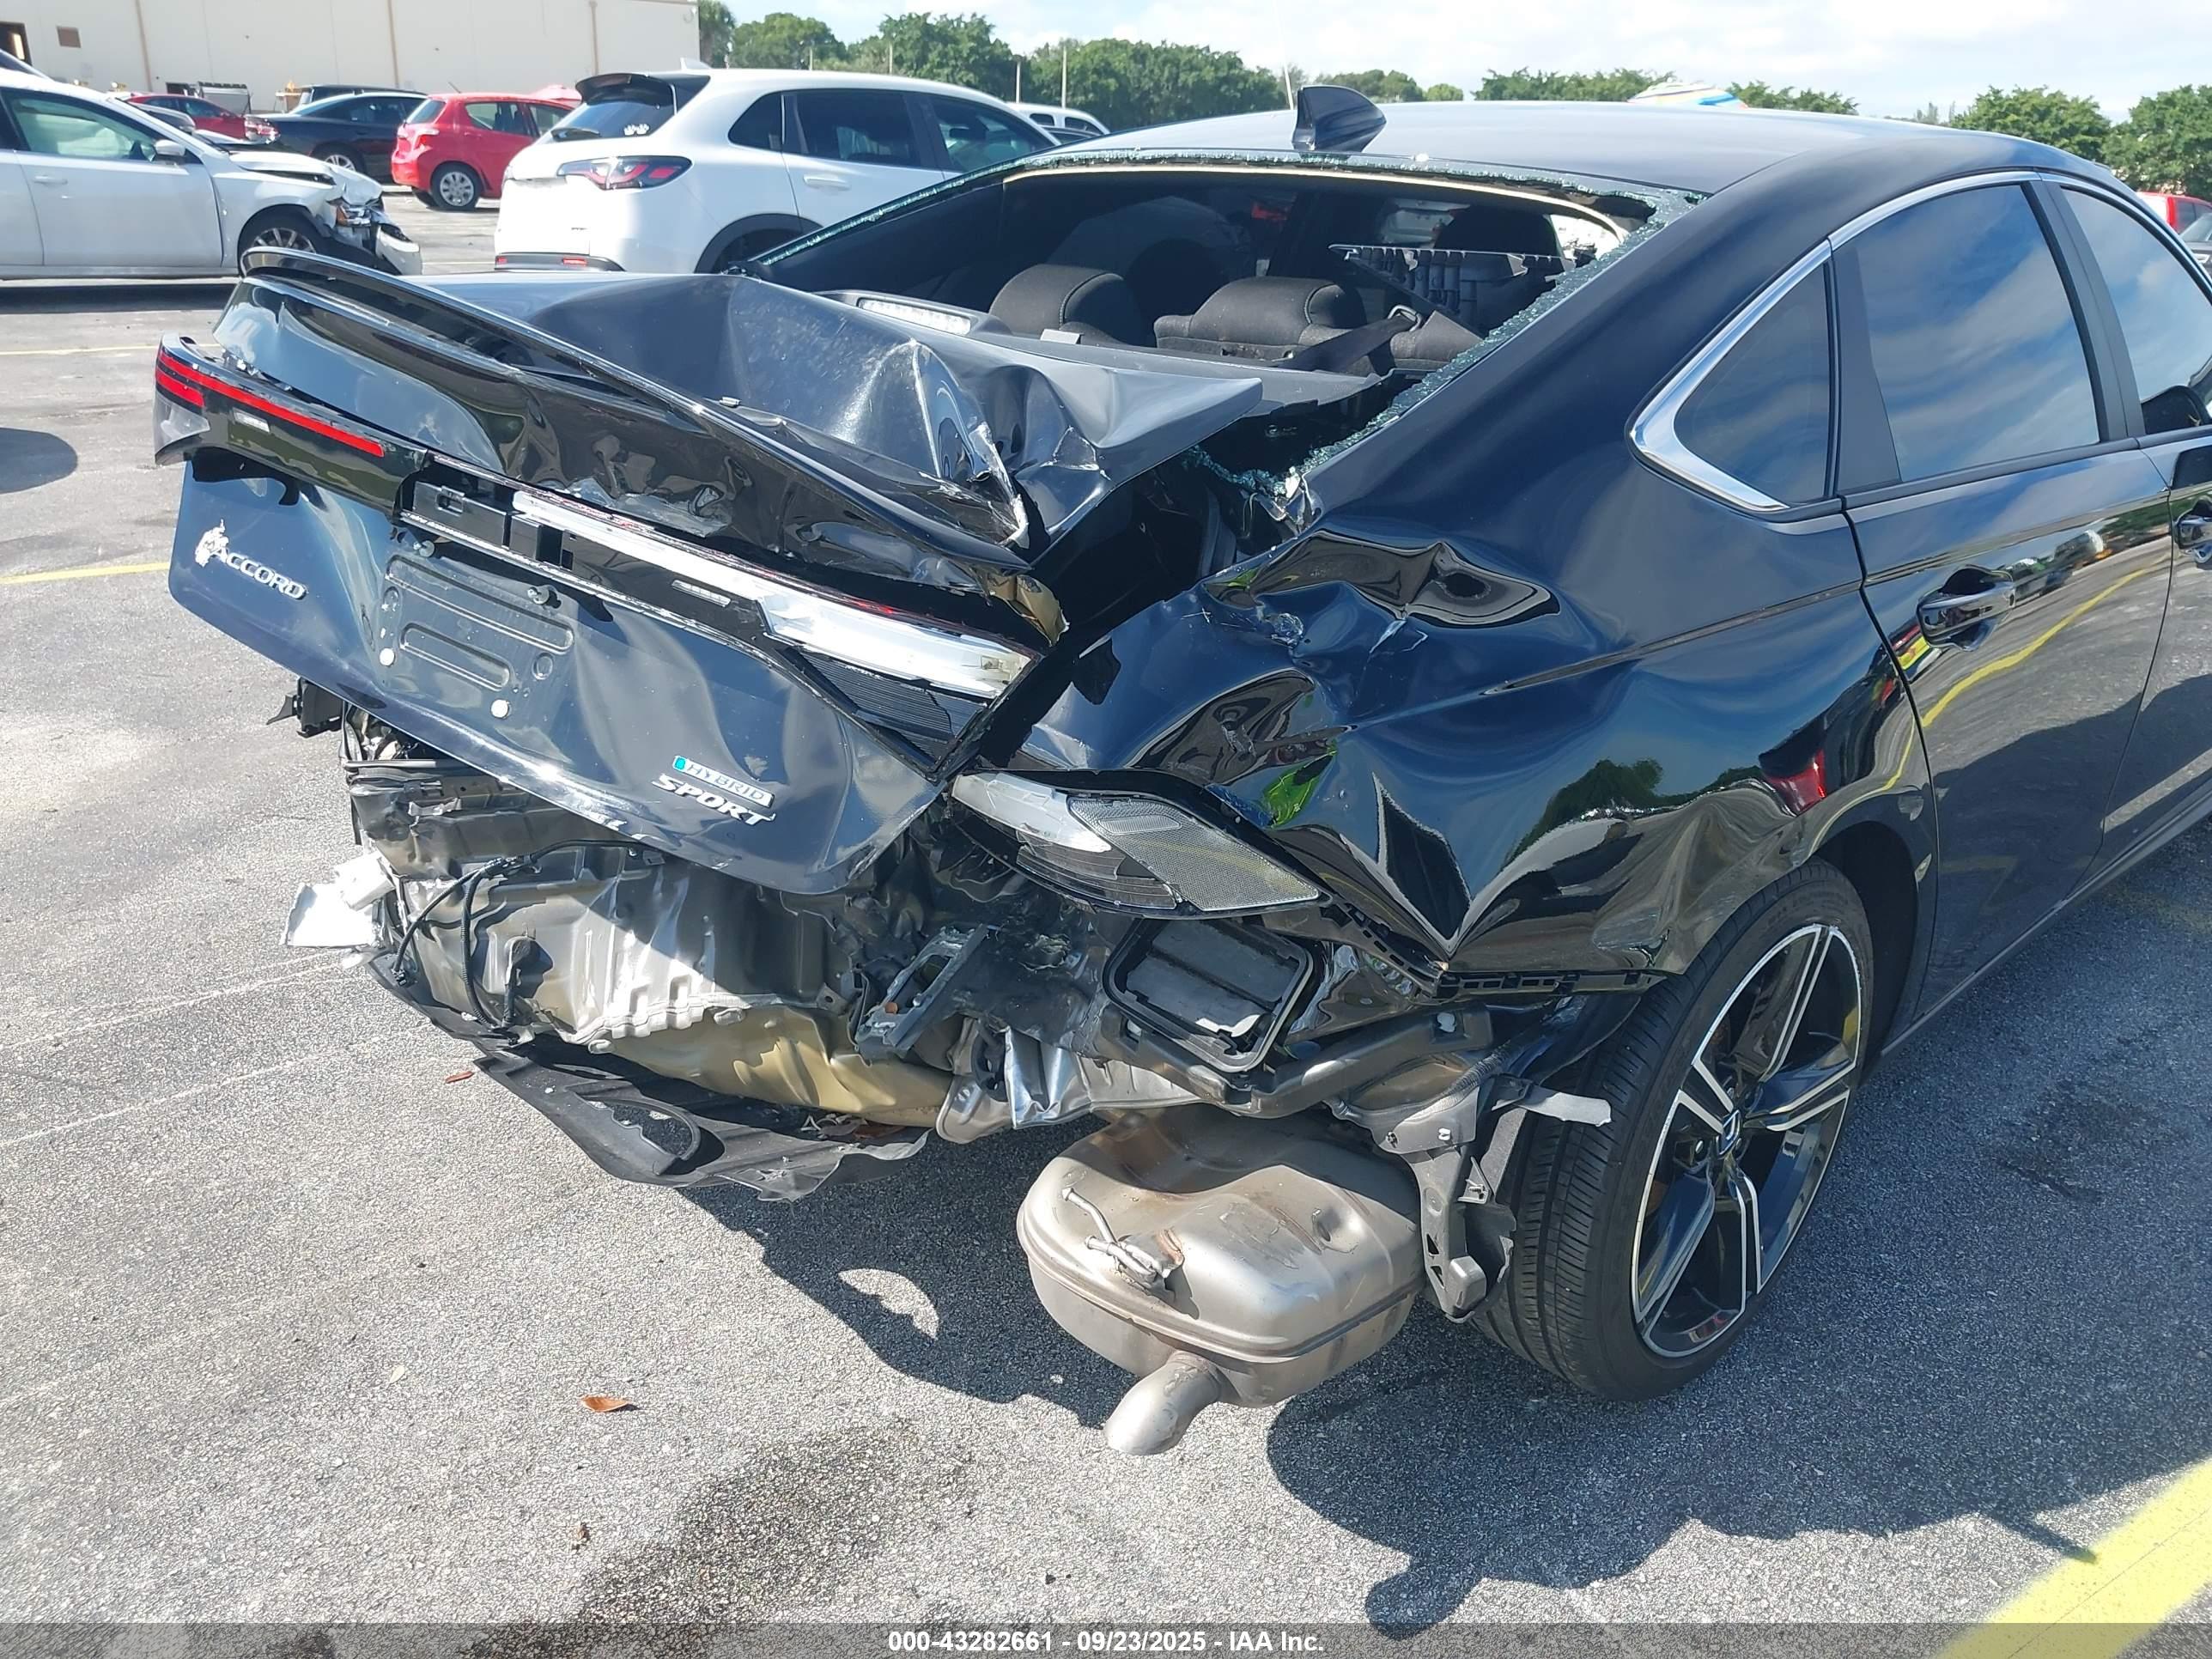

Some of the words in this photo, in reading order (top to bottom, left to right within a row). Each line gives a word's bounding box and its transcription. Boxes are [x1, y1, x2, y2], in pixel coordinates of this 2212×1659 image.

[210, 547, 308, 599] ACCORD
[652, 773, 776, 826] SPORT
[687, 763, 765, 800] HYBRID
